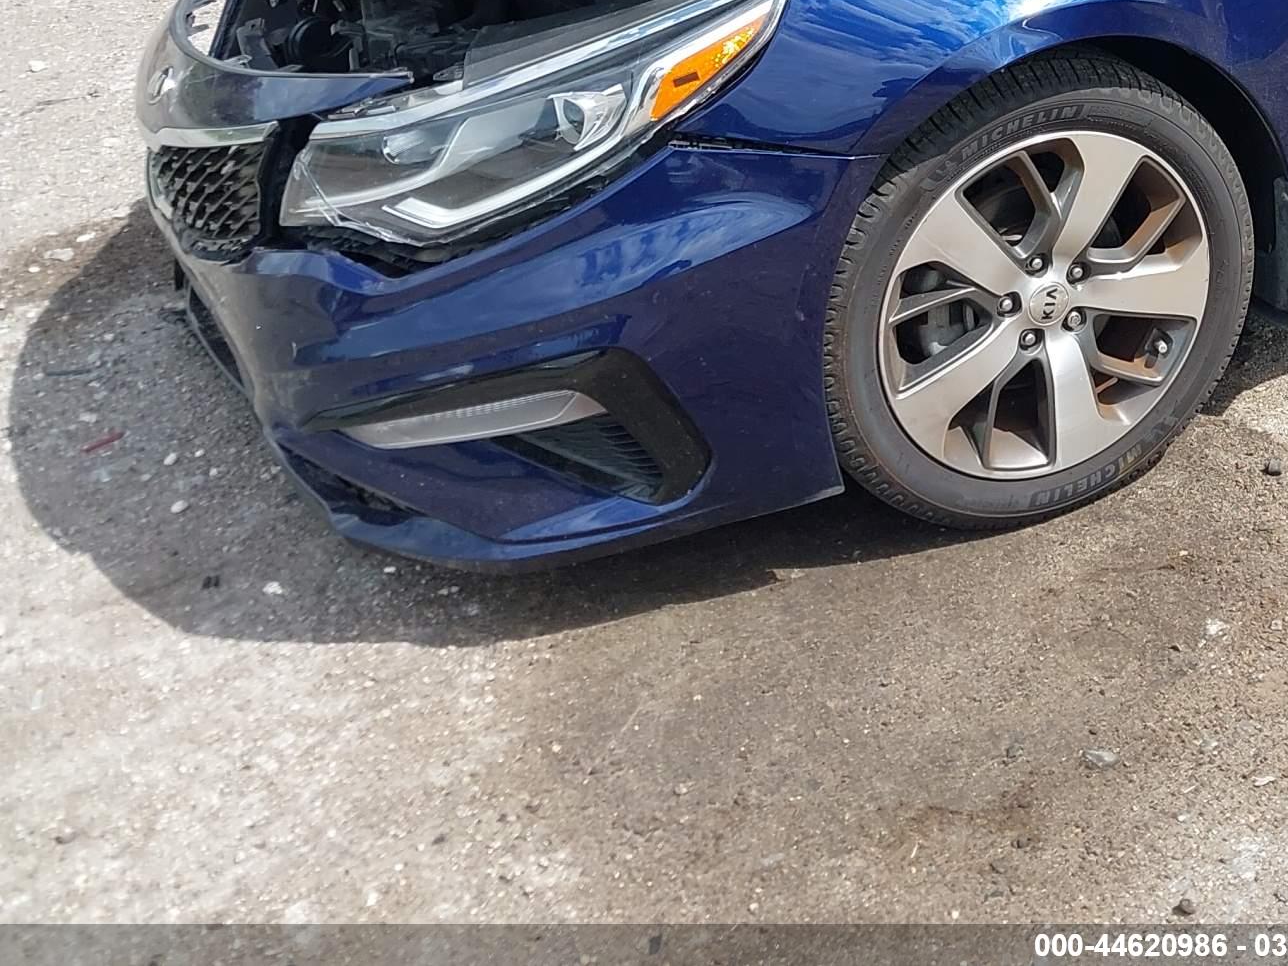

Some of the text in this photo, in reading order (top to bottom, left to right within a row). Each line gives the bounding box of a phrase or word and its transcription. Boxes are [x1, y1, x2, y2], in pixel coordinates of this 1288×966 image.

[961, 104, 1080, 161] MICHELIN
[1041, 288, 1058, 320] KIA
[1036, 444, 1143, 505] MICHELIN
